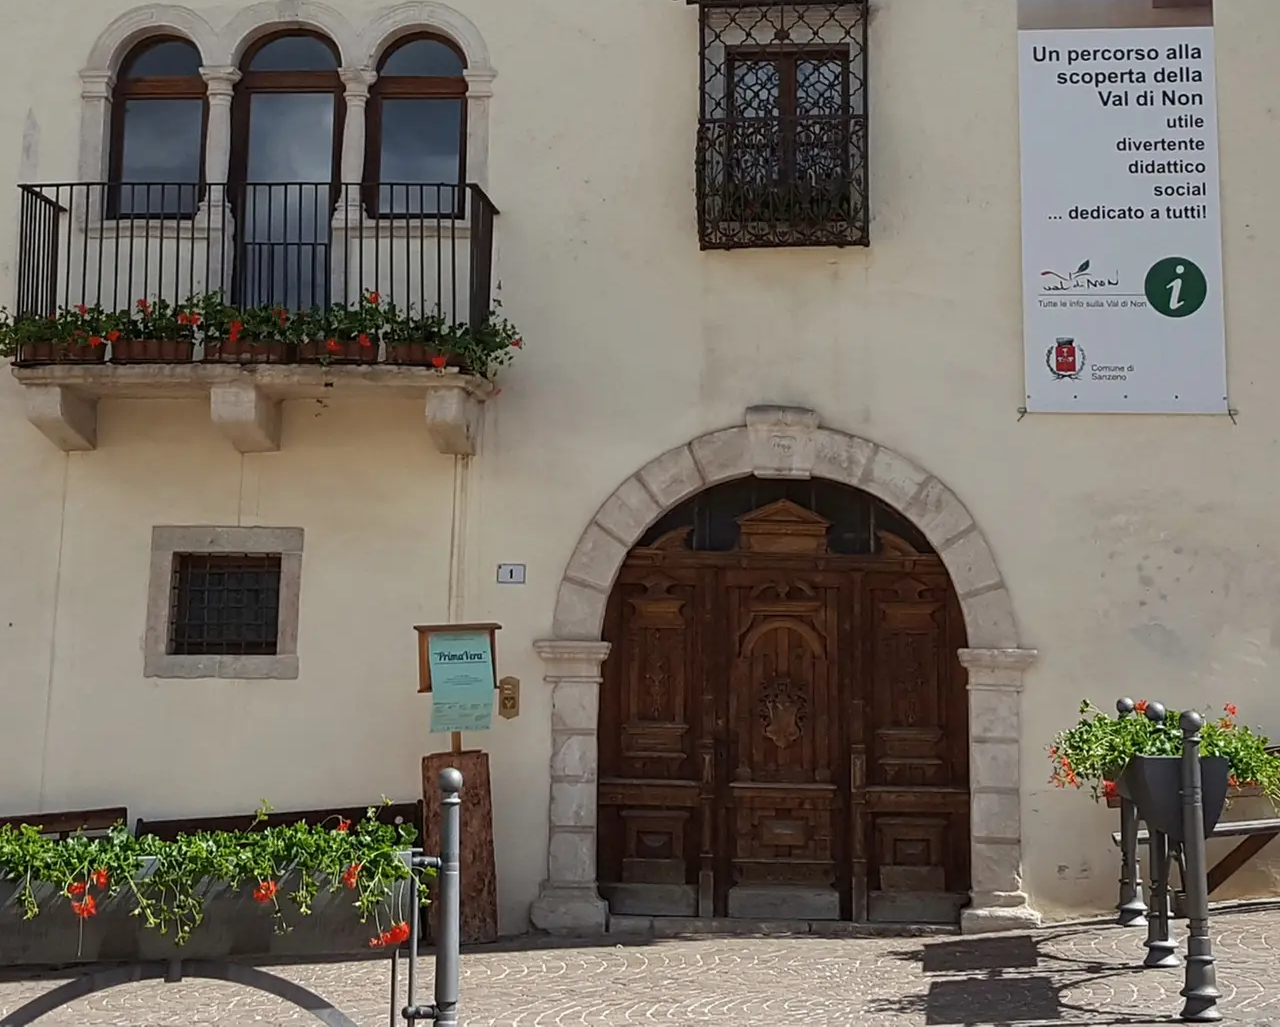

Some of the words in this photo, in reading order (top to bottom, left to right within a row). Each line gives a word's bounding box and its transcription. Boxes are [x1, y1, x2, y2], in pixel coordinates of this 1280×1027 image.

[1032, 46, 1060, 62] Un
[1067, 48, 1159, 66] percorso
[1166, 43, 1202, 60] alla
[1056, 69, 1147, 88] scoperta
[1153, 66, 1203, 83] della
[1097, 90, 1129, 107] Val
[1135, 89, 1154, 106] di
[1161, 89, 1203, 106] Non
[1166, 114, 1205, 129] utile
[1116, 137, 1205, 152] divertente
[1128, 159, 1206, 174] didattico
[1153, 181, 1207, 197] social
[1068, 205, 1145, 220] dedicato
[1150, 208, 1160, 220] a
[1165, 204, 1207, 220] tutti!
[1037, 299, 1059, 308] Tutte
[1060, 299, 1067, 308] le
[1069, 299, 1084, 308] info
[1086, 299, 1104, 308] sulla
[1106, 299, 1119, 307] Val
[1121, 299, 1129, 307] di
[1130, 299, 1147, 307] Non
[1091, 363, 1125, 372] Comune
[1127, 363, 1135, 372] di
[1091, 372, 1127, 381] Sanzeno
